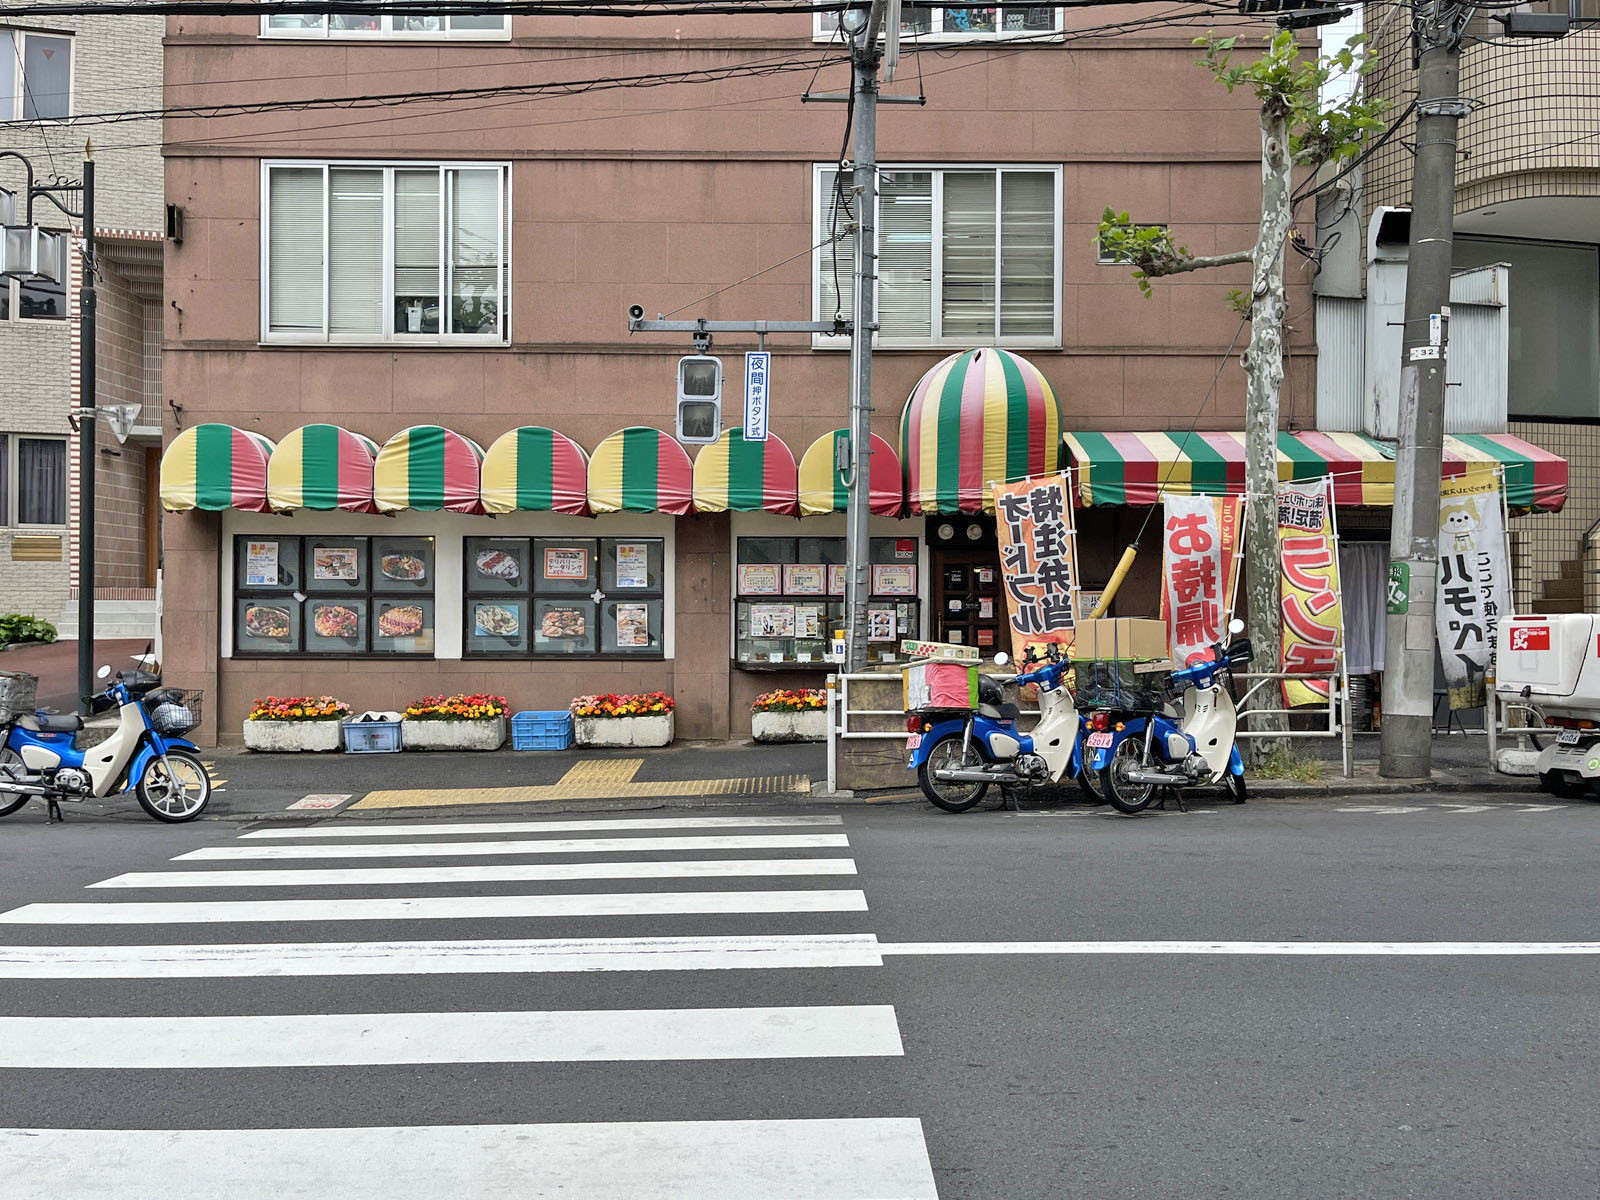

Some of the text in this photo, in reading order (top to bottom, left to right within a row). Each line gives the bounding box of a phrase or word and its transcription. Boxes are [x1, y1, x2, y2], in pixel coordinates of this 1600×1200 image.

[751, 357, 764, 436] 夜間押ボタン式
